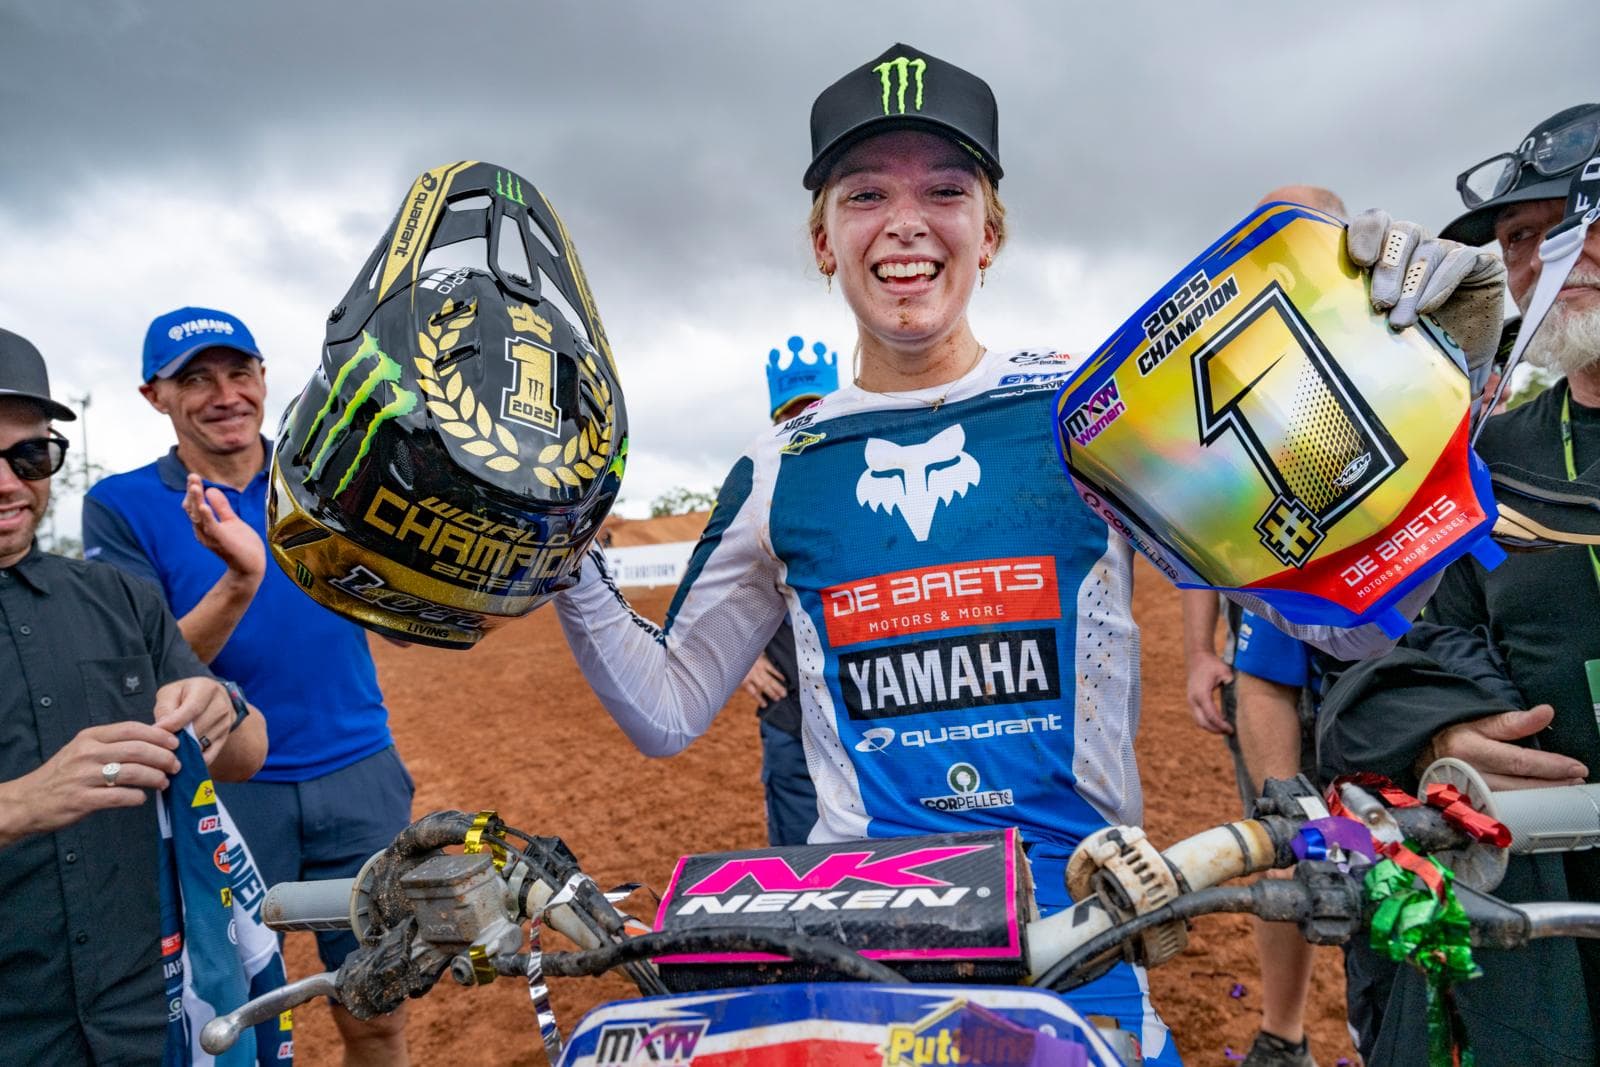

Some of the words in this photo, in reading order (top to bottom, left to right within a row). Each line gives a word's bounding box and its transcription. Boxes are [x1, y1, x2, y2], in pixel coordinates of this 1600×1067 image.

[394, 191, 429, 258] quadrant
[181, 318, 234, 333] YAMAHA
[1137, 276, 1239, 376] CHAMPION
[1143, 271, 1211, 341] 2025
[512, 399, 553, 424] 2025
[1190, 280, 1408, 530] 1
[418, 496, 571, 548] WORLD
[1340, 554, 1380, 588] DE
[1375, 494, 1457, 562] BAETS
[430, 560, 533, 592] 2025
[1356, 569, 1394, 598] MOTORS
[1402, 542, 1430, 565] MORE
[1428, 511, 1469, 546] HASSELT
[831, 583, 880, 618] DE
[890, 563, 1044, 607] BAETS
[406, 622, 450, 639] LIVING
[868, 613, 933, 633] MOTORS
[939, 610, 951, 622] &
[958, 604, 1005, 618] MORE
[848, 639, 1050, 712] YAMAHA
[901, 714, 1062, 748] quadrant
[924, 791, 1013, 811] CORPELLETS
[675, 886, 972, 916] NEKEN
[596, 1023, 707, 1064] MXW
